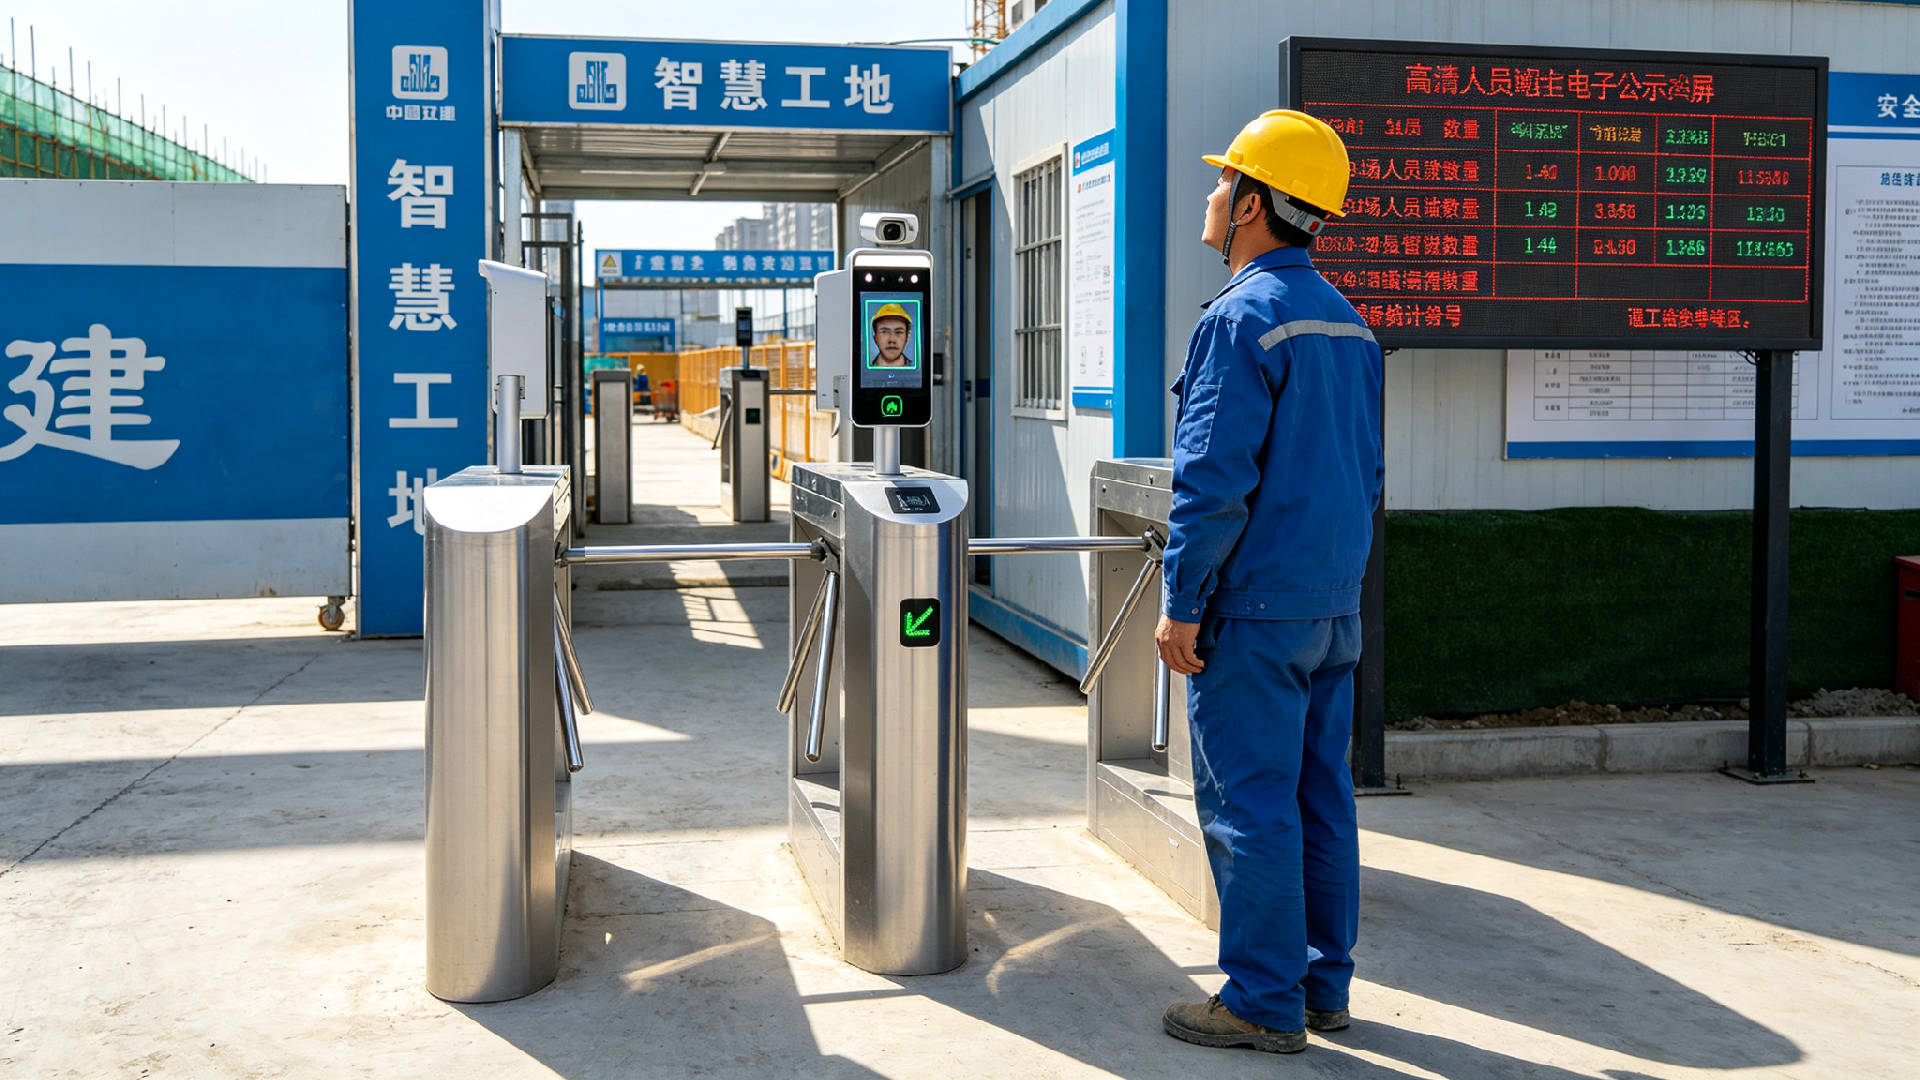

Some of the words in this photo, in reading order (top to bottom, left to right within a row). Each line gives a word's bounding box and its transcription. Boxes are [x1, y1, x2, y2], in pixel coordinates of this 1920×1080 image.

[654, 57, 894, 114] 智慧工地
[1877, 93, 1920, 118] 安全
[0, 323, 181, 470] 建
